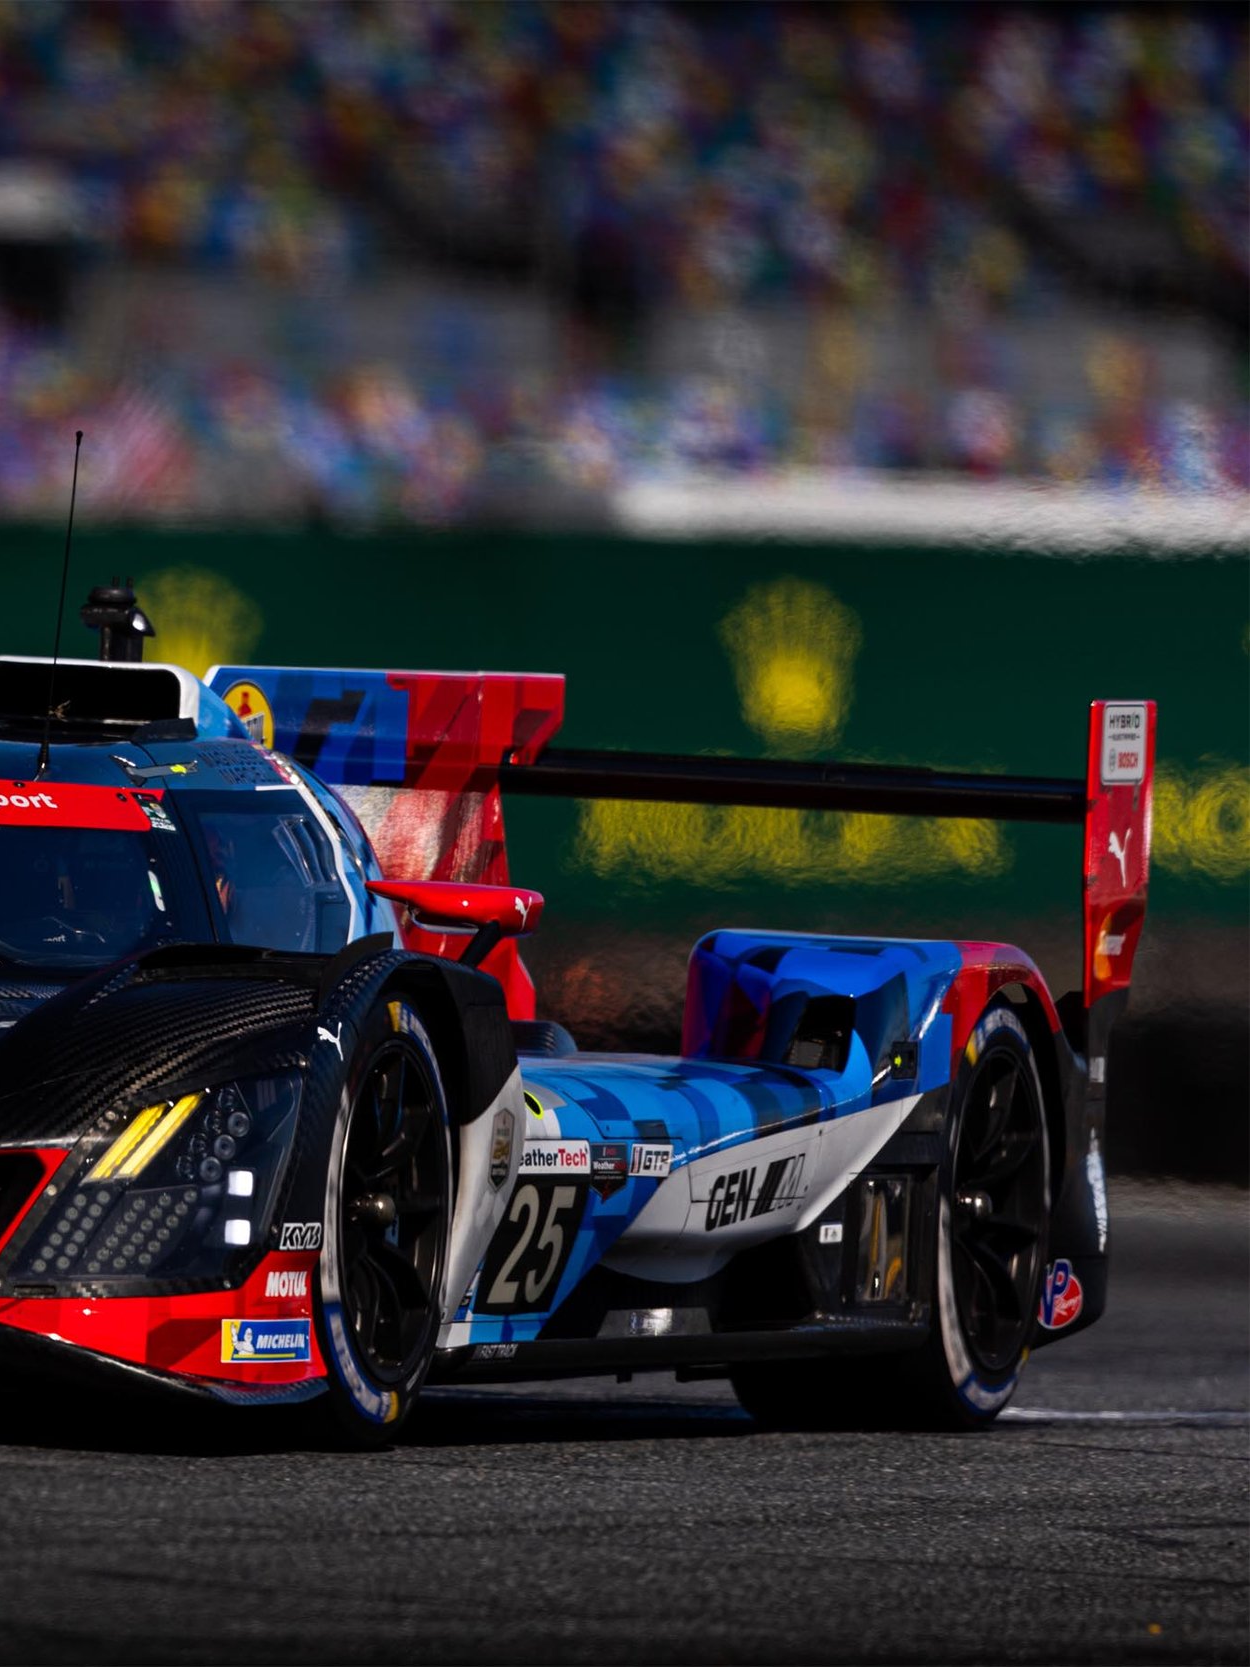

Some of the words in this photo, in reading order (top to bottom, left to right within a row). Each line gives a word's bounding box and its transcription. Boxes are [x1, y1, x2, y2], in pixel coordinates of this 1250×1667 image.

[519, 1148, 588, 1168] eatherTech
[643, 1150, 669, 1171] GTP
[705, 1166, 758, 1232] GEN
[279, 1222, 322, 1250] KYB
[487, 1184, 577, 1304] 25
[265, 1271, 308, 1298] MOTUL
[256, 1334, 306, 1350] MICHELIN
